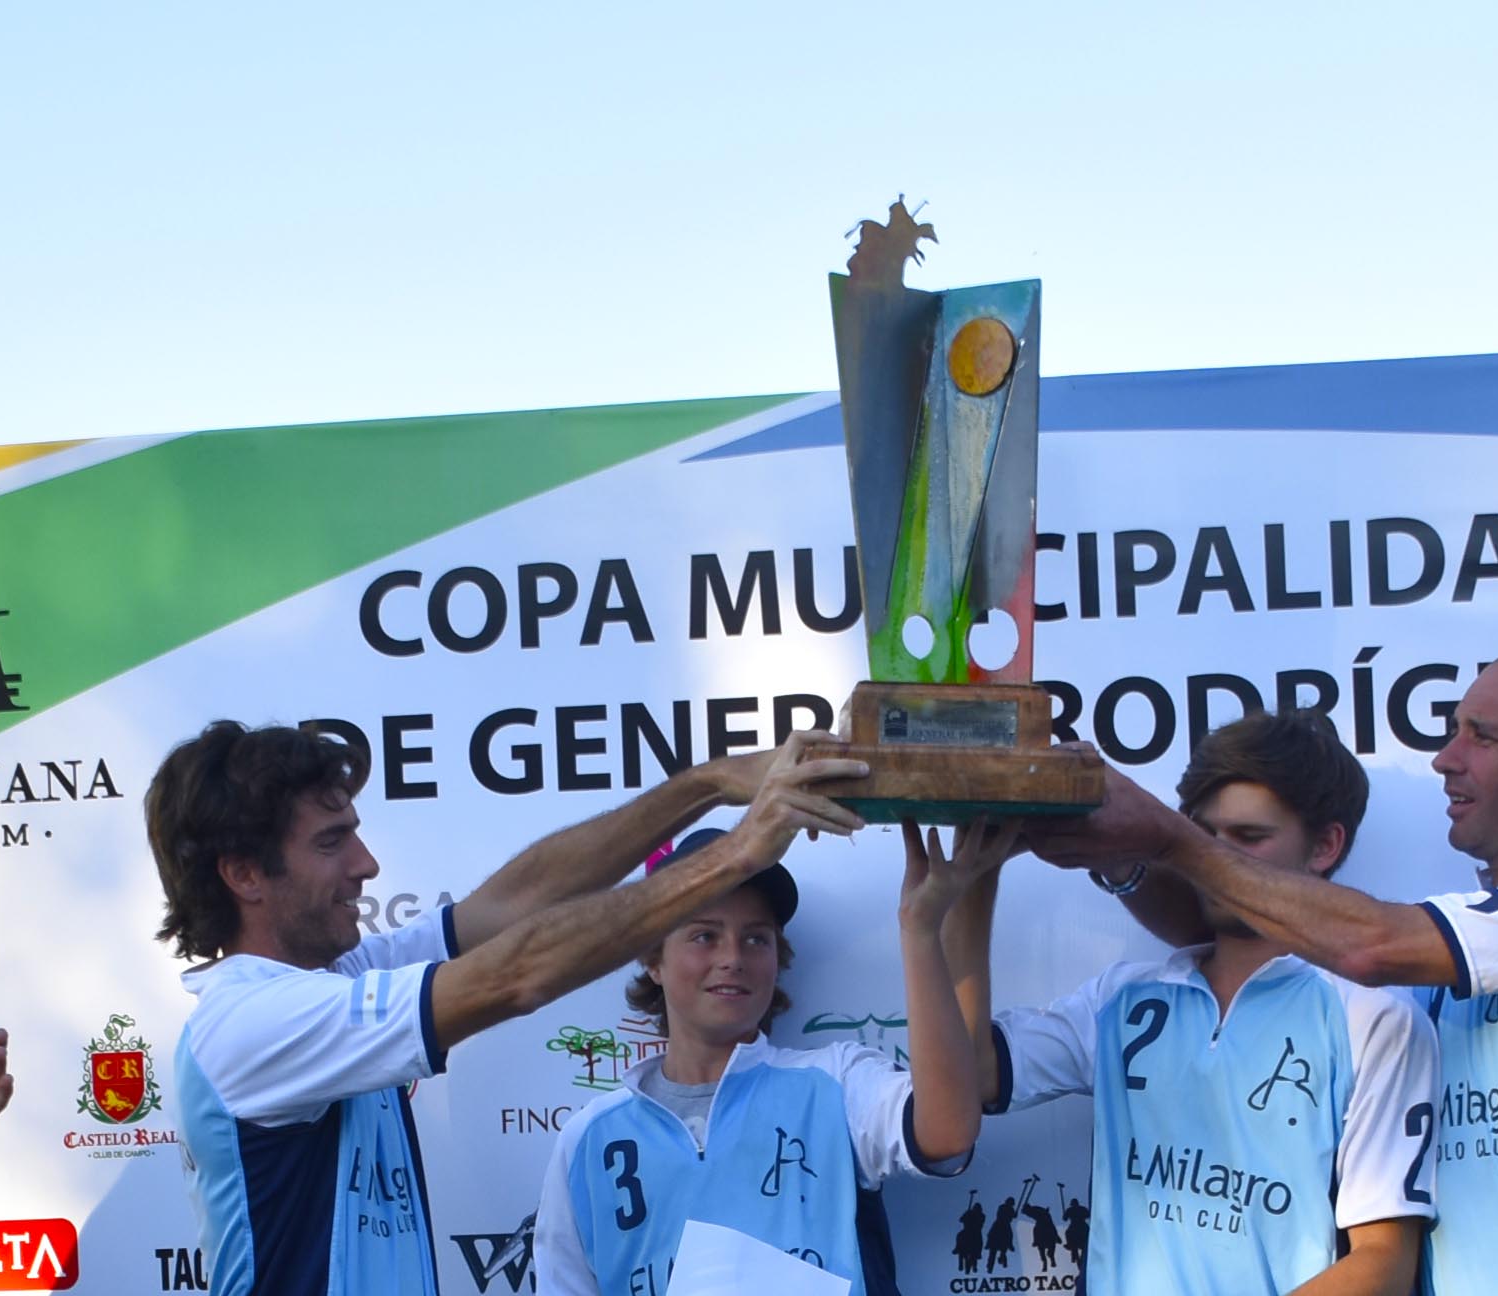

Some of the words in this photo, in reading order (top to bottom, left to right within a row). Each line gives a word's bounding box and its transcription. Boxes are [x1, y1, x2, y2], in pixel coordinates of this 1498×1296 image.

[359, 559, 655, 659] COPA
[468, 693, 835, 796] GENER
[1122, 998, 1169, 1091] 2
[63, 1131, 131, 1149] CASTELO
[134, 1128, 179, 1146] REAL
[502, 1106, 574, 1134] FINC
[1404, 1102, 1434, 1205] 2
[603, 1138, 647, 1232] 3
[155, 1247, 209, 1291] TAC
[950, 1277, 1031, 1294] CUATRO
[1034, 1274, 1078, 1291] TAC
